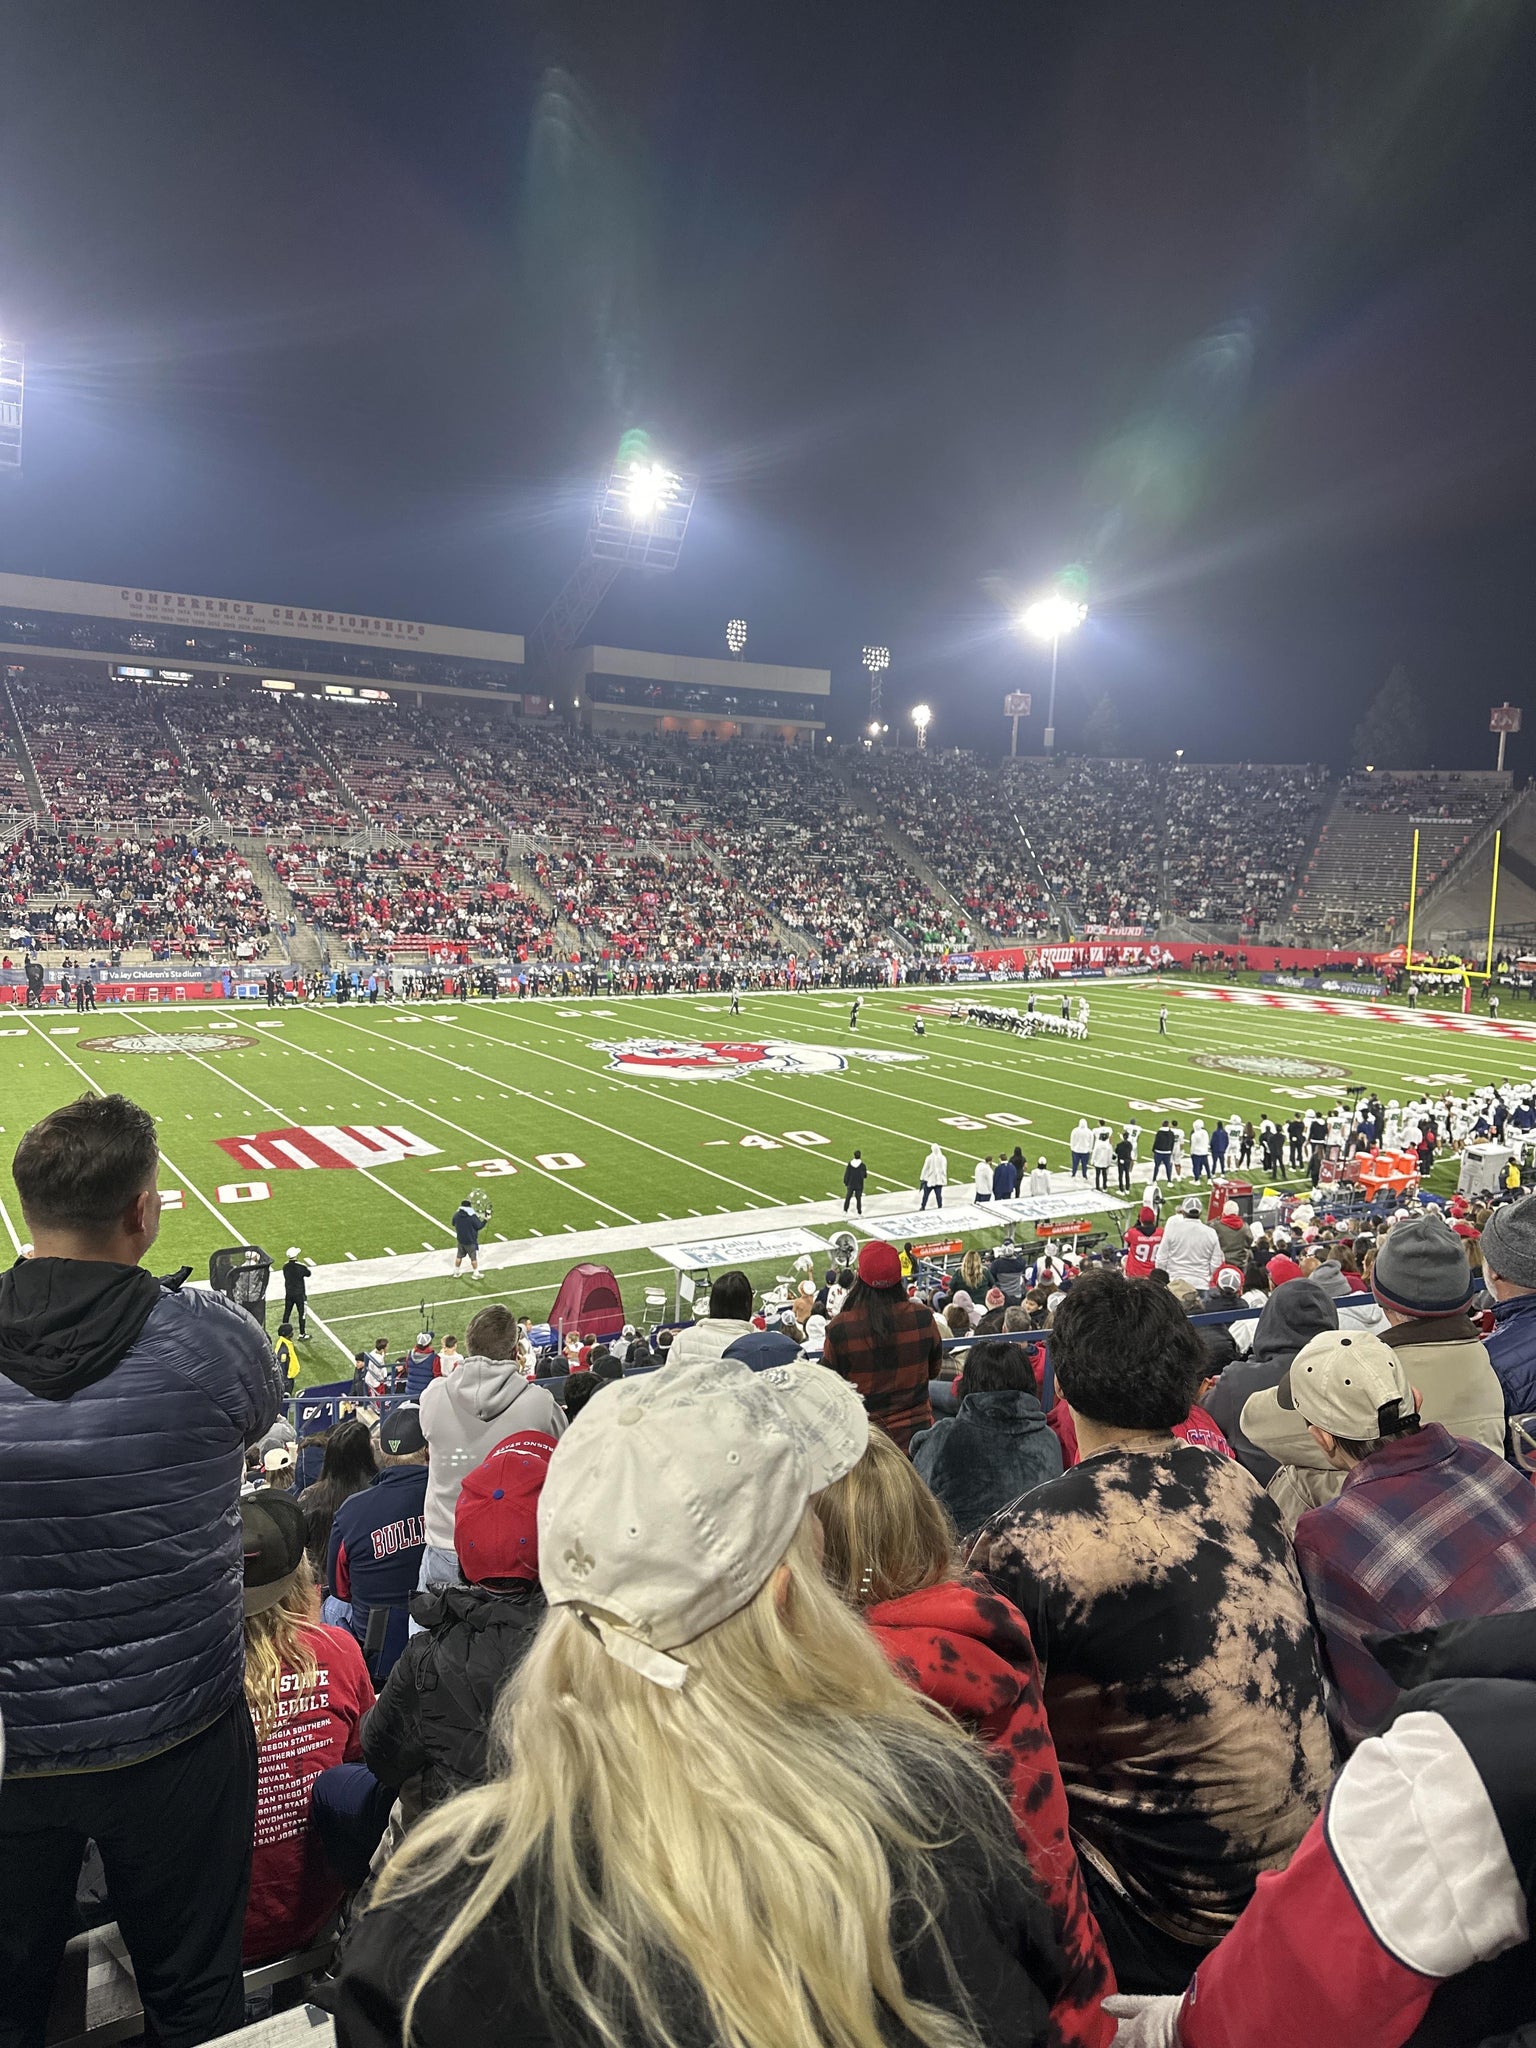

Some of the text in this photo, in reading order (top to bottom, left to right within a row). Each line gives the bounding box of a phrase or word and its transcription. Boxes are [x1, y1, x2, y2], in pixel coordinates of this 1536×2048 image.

[121, 590, 254, 615] CONFERENCE
[272, 608, 425, 635] CHAMPIONSHIPS
[133, 969, 170, 979] Children's
[171, 970, 202, 978] Stadium
[937, 1112, 1034, 1131] 50
[739, 1130, 832, 1150] 40
[466, 1152, 587, 1178] 30
[1051, 1225, 1081, 1234] GATORADE
[713, 1239, 764, 1251] Valley
[725, 1241, 803, 1256] Children's
[920, 1245, 951, 1255] GATORADE
[523, 1440, 555, 1453] RESNO
[280, 1669, 330, 1693] STATE
[261, 1740, 289, 1753] REGON
[257, 1749, 296, 1764] SOUTHERN
[257, 1778, 301, 1796] COLORADO
[258, 1795, 276, 1806] SAN
[277, 1789, 302, 1801] DIEGO
[257, 1805, 283, 1816] BOISE
[258, 1824, 281, 1836] UTAH
[258, 1835, 276, 1846] SAN
[277, 1828, 298, 1841] JOSE
